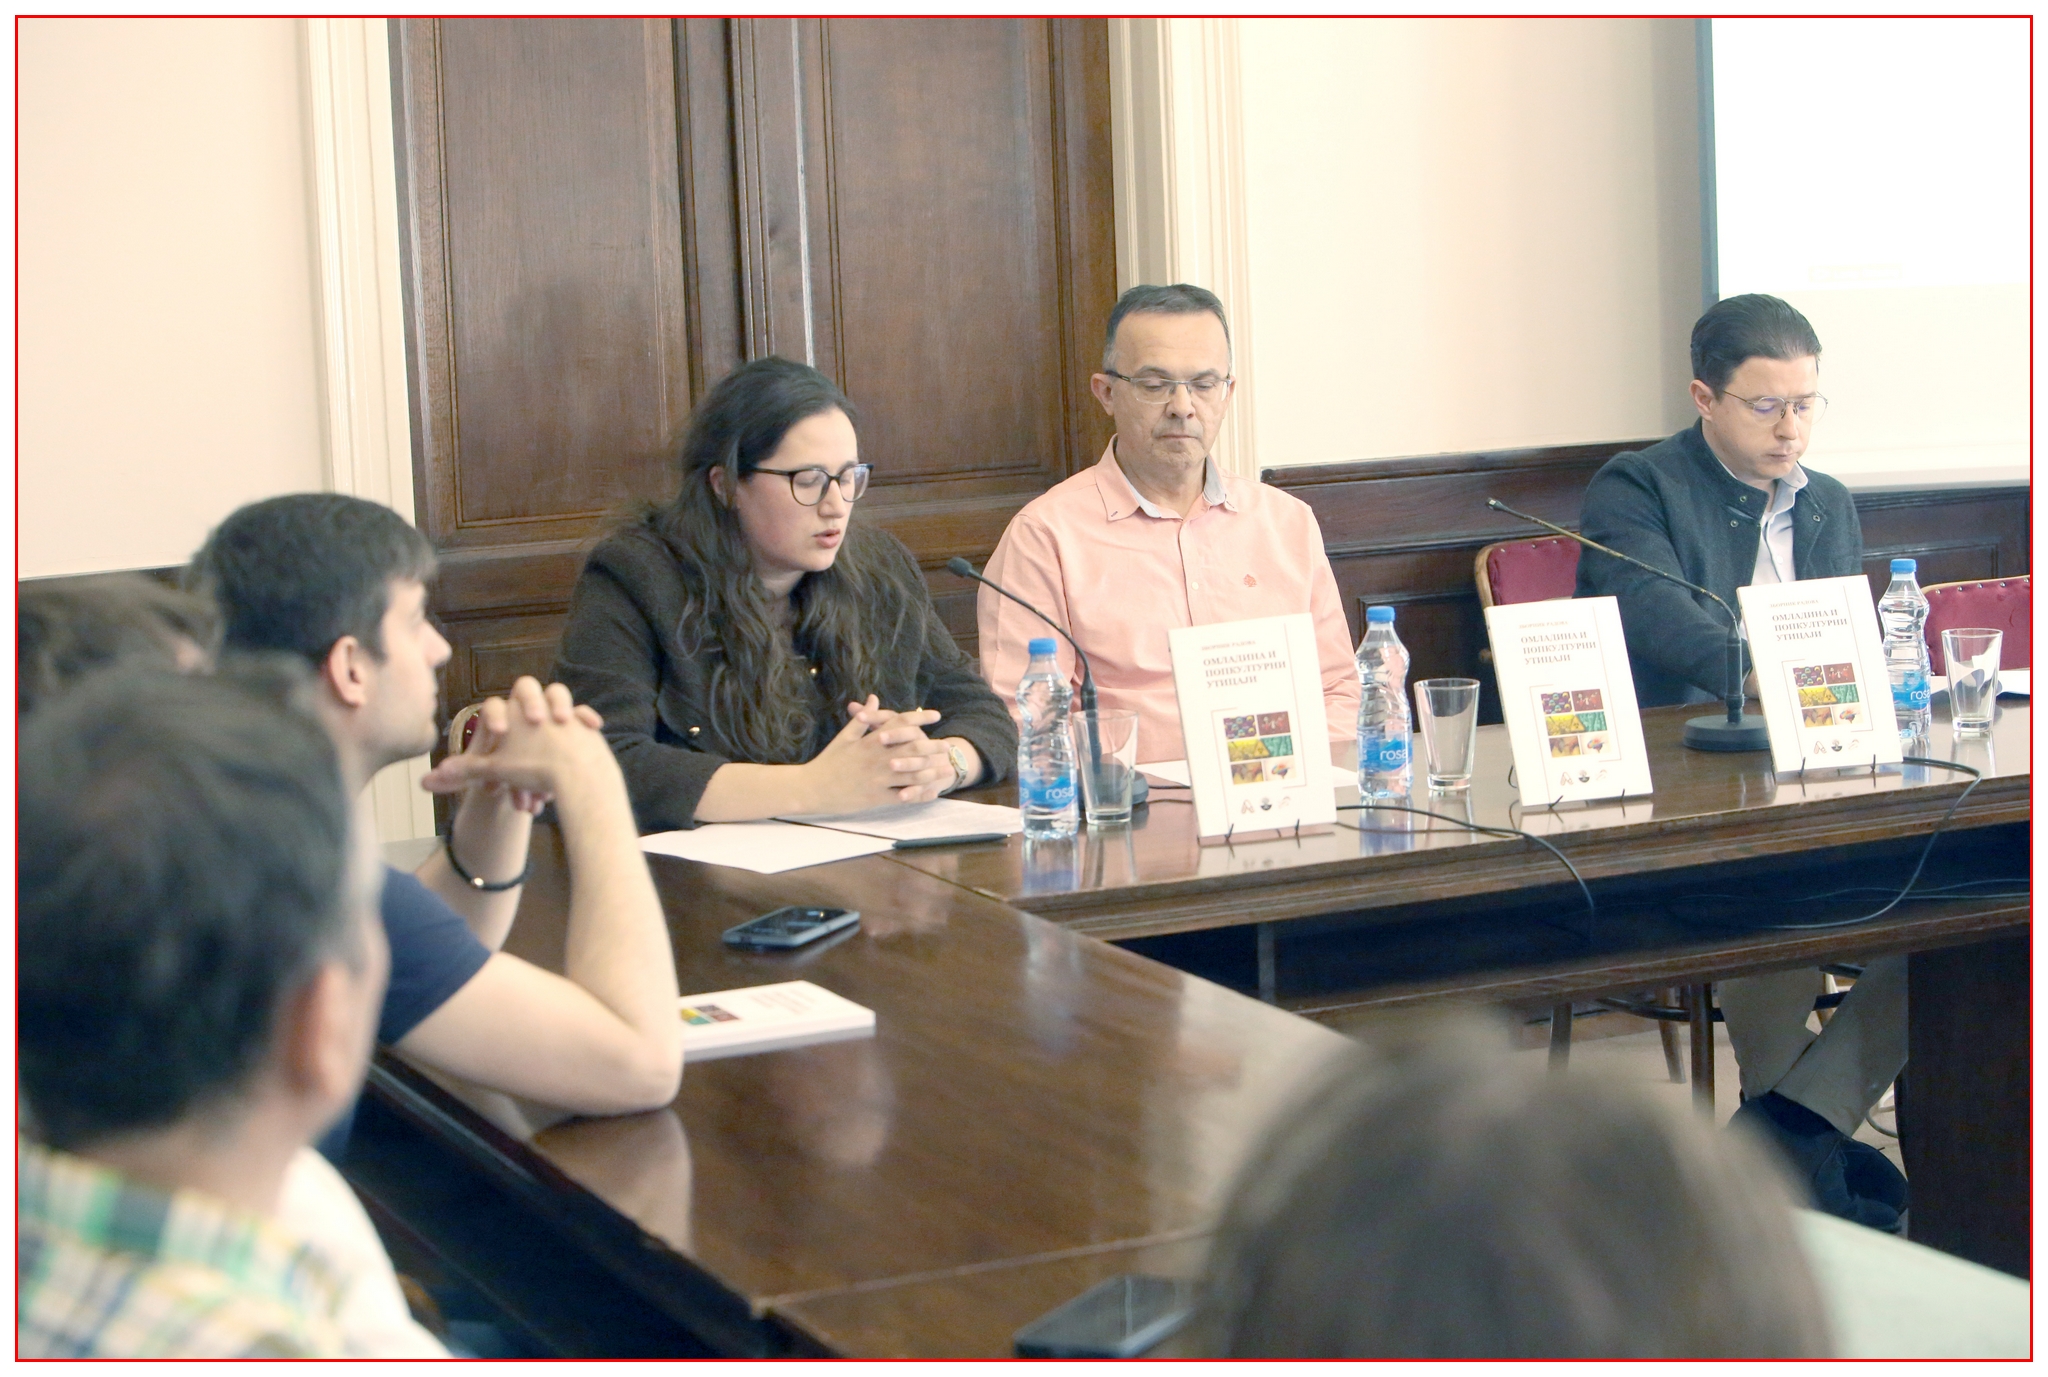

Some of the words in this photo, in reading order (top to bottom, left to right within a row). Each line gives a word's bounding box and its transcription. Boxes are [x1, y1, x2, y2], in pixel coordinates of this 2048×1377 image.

[1771, 610, 1829, 622] ОМЛАДИНА
[1774, 618, 1848, 632] ПОПКУЛТУРНИ
[1521, 632, 1578, 643] ОМЛАДИНА
[1579, 631, 1587, 639] И
[1776, 630, 1822, 642] УТИЦАЈИ
[1523, 641, 1597, 655] ПОПКУЛТУРНИ
[1203, 652, 1266, 666] ОМЛАДИНА
[1268, 650, 1276, 659] И
[1525, 654, 1571, 665] УТИЦАЈИ
[1205, 661, 1286, 677] ПОПКУЛТУРНИ
[1207, 675, 1257, 688] УТИЦАЈИ
[1380, 749, 1407, 761] rosa
[1045, 786, 1075, 800] rosa
